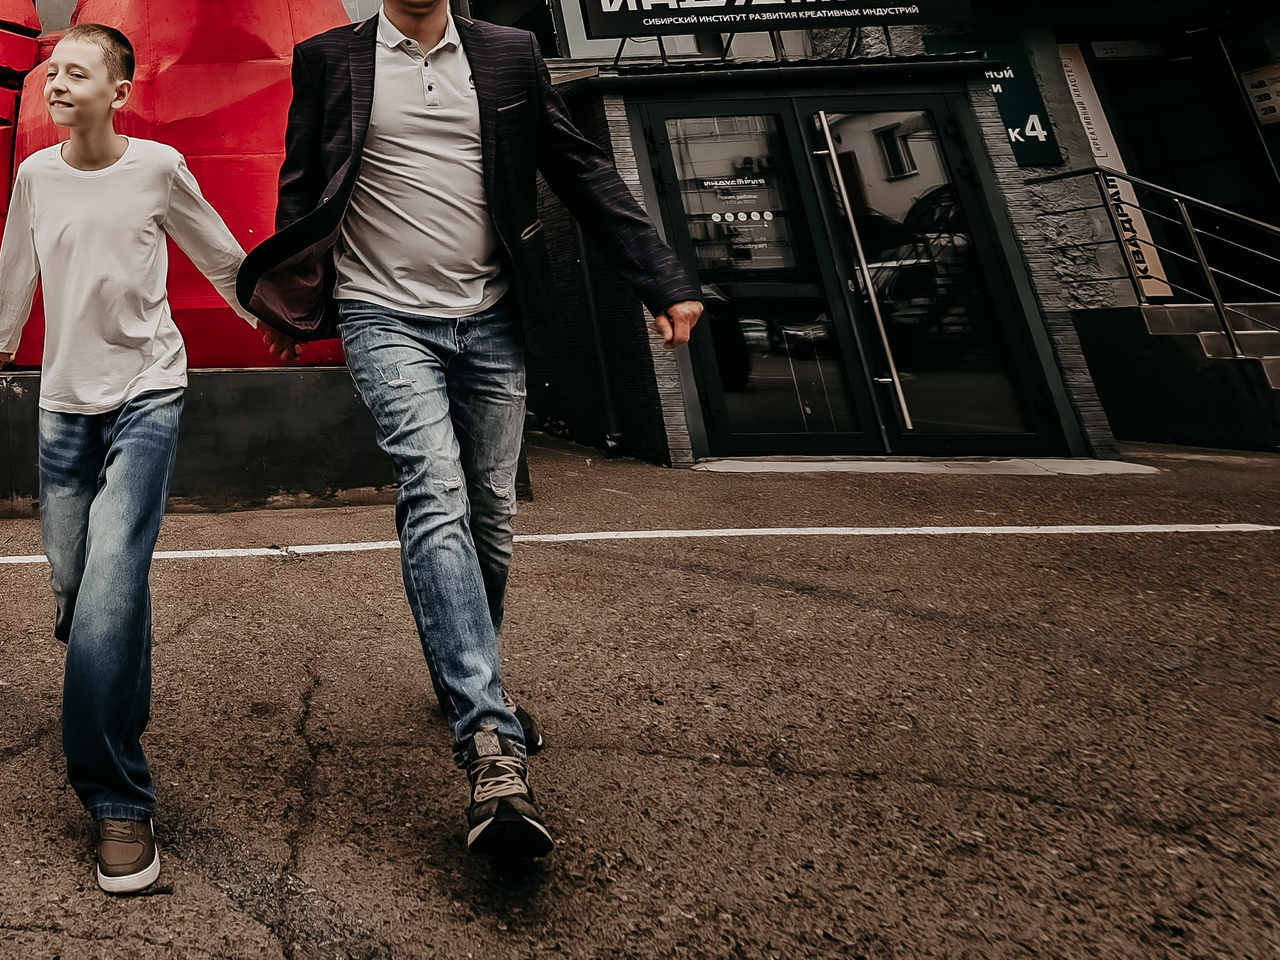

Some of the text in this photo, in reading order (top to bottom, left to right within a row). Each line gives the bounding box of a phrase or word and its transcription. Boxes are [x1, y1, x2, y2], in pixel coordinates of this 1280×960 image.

[642, 4, 920, 26] СИБИРСКИЙ ИНСТИТУТ РАЗВИТИЯ КРЕАТИВНЫХ ИНДУСТРИЙ
